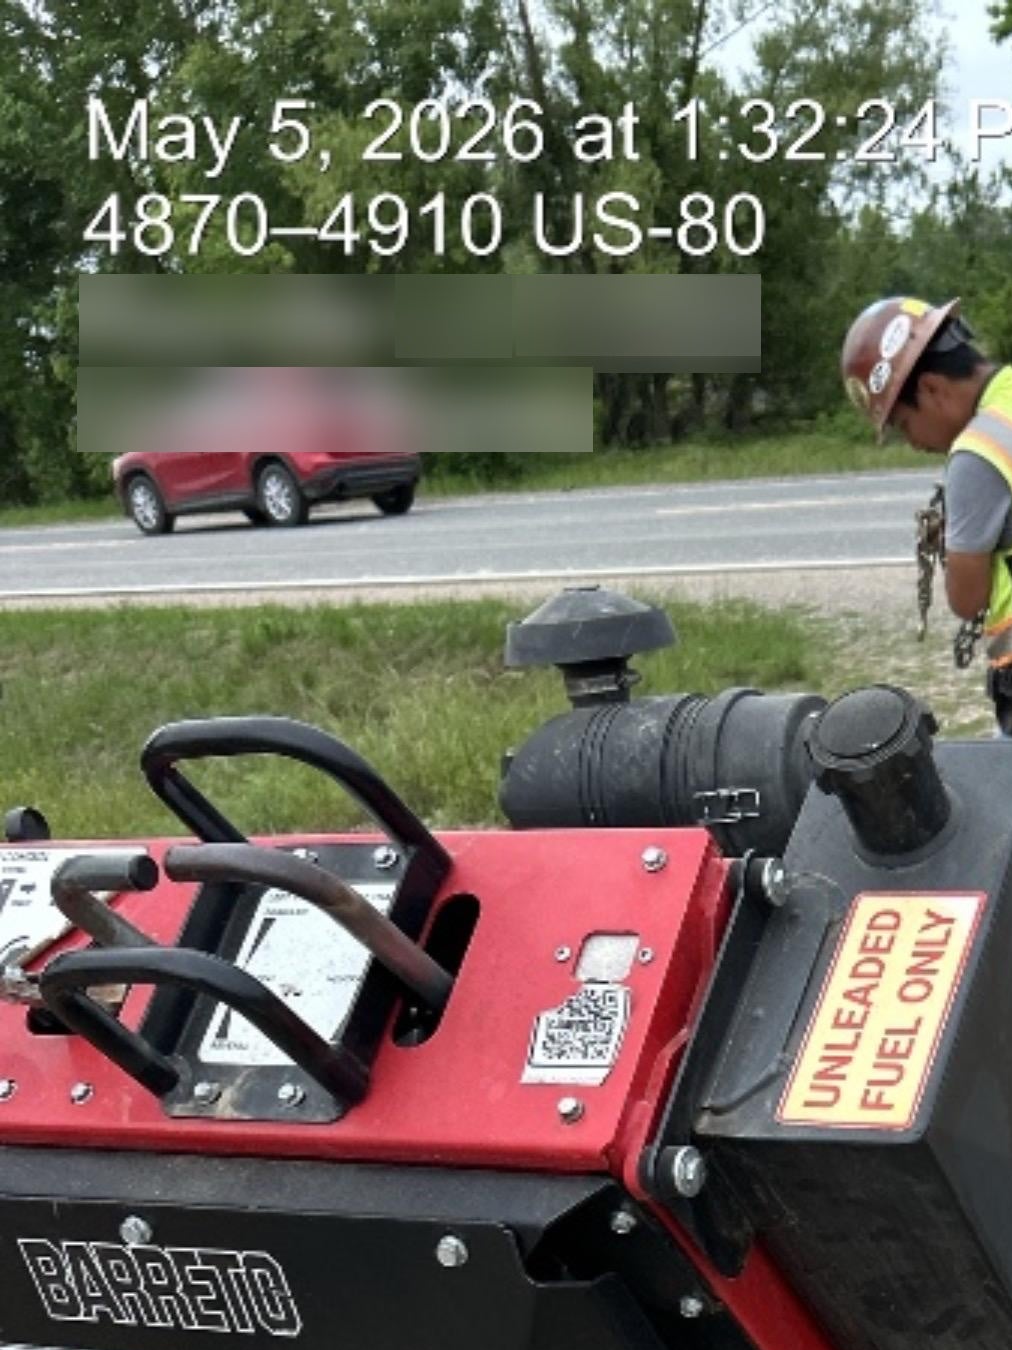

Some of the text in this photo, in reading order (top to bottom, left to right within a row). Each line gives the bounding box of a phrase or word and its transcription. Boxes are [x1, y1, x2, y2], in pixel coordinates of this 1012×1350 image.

[802, 908, 902, 1108] UNLEADED
[858, 908, 957, 1111] FUEL ONLY
[16, 1237, 303, 1338] BARRETO
